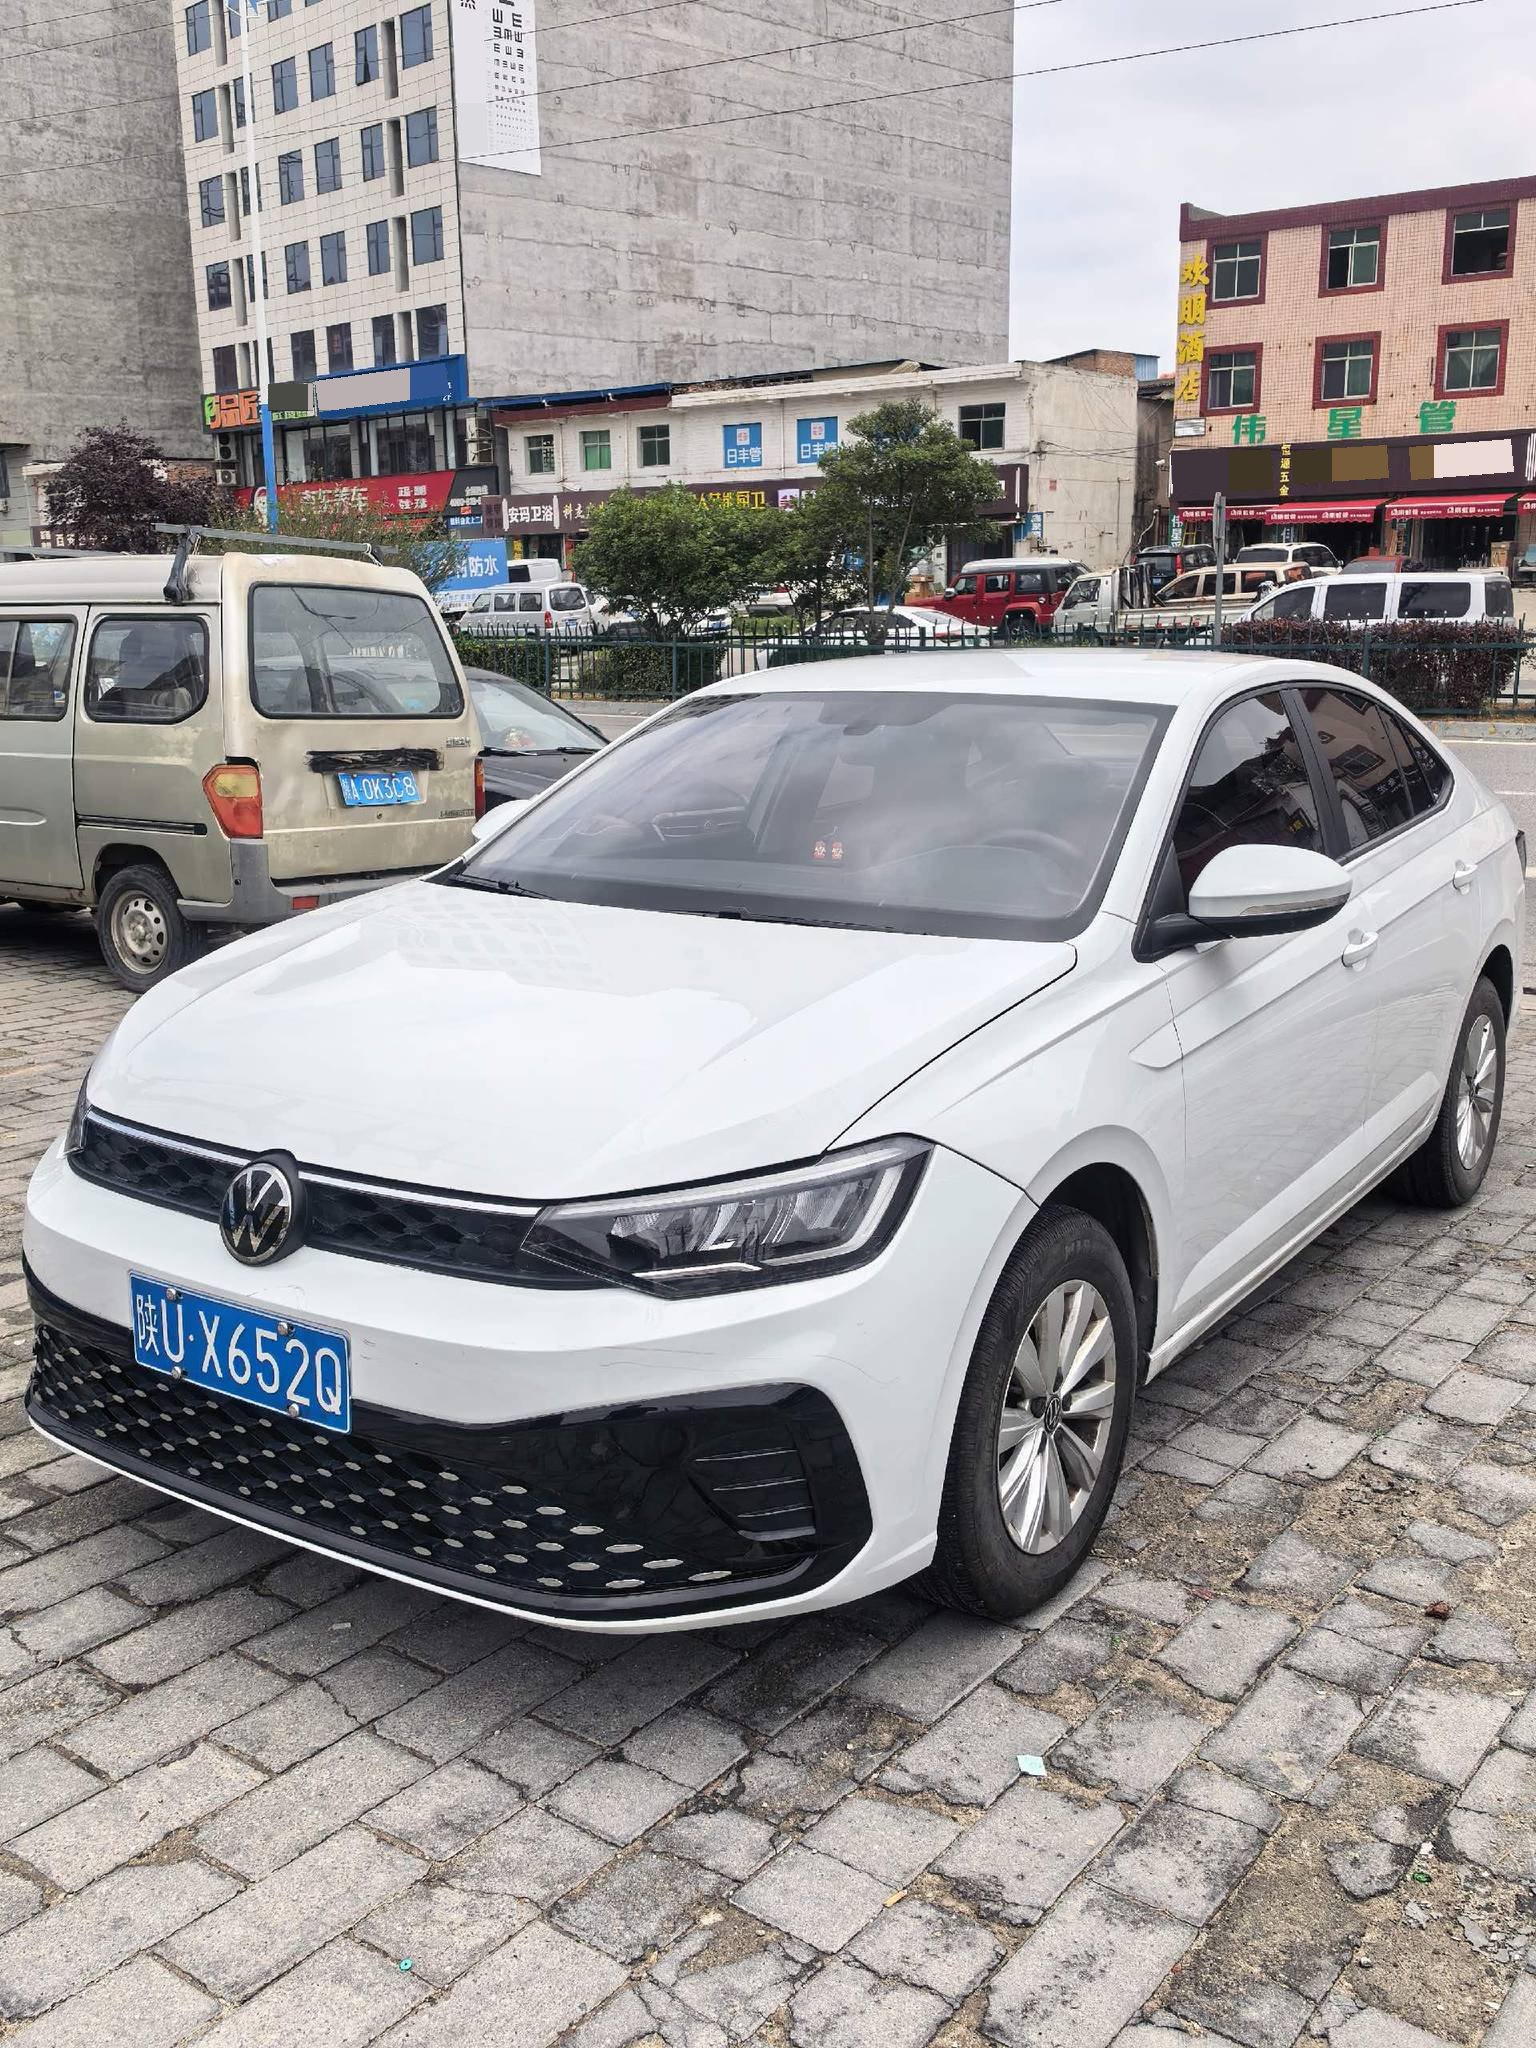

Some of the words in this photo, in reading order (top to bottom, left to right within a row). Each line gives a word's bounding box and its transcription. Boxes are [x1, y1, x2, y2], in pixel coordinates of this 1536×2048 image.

[1232, 401, 1457, 445] 伟星管
[727, 446, 762, 463] 日丰管
[136, 1294, 342, 1415] 陕U·X652Q
